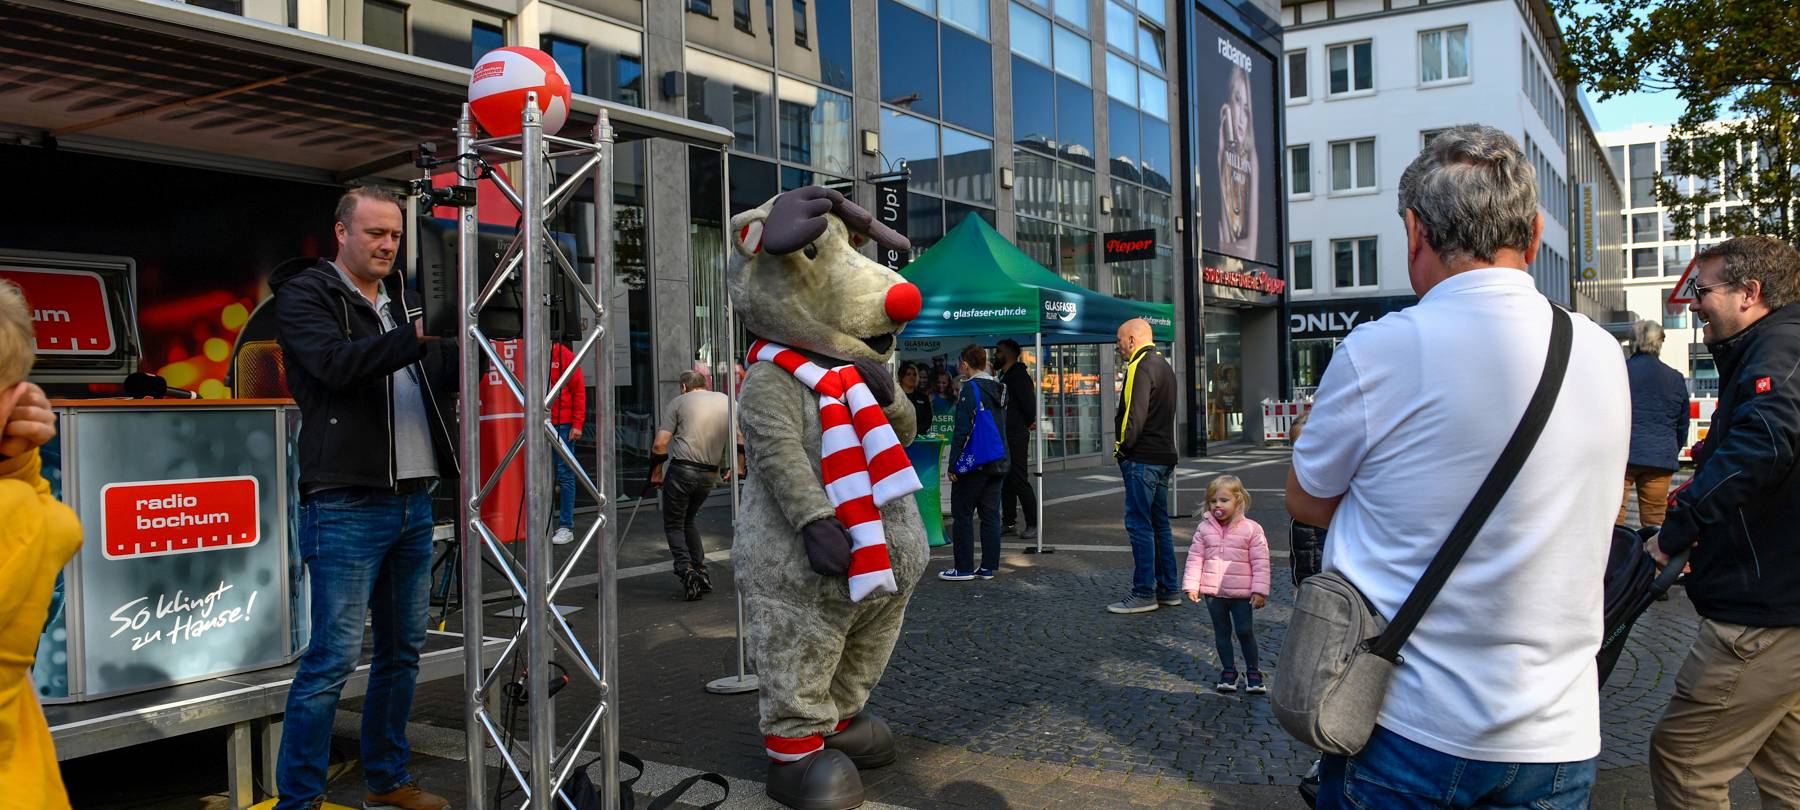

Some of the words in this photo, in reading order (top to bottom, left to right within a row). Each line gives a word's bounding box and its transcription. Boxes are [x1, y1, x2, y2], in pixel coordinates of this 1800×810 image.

[1217, 36, 1252, 73] rabanne
[883, 186, 900, 222] Up!
[1583, 186, 1593, 262] COMMERZBANK
[1106, 239, 1153, 254] Pieper
[953, 306, 1027, 320] glasfaser-ruhr.de
[1044, 300, 1077, 313] GLASFASER
[1290, 311, 1360, 333] ONLY
[931, 414, 954, 423] ASER
[136, 493, 198, 511] radio
[136, 511, 230, 530] bochum
[110, 596, 150, 638] So
[156, 580, 234, 619] klingt
[131, 629, 162, 651] zu
[166, 590, 259, 645] Hause!
